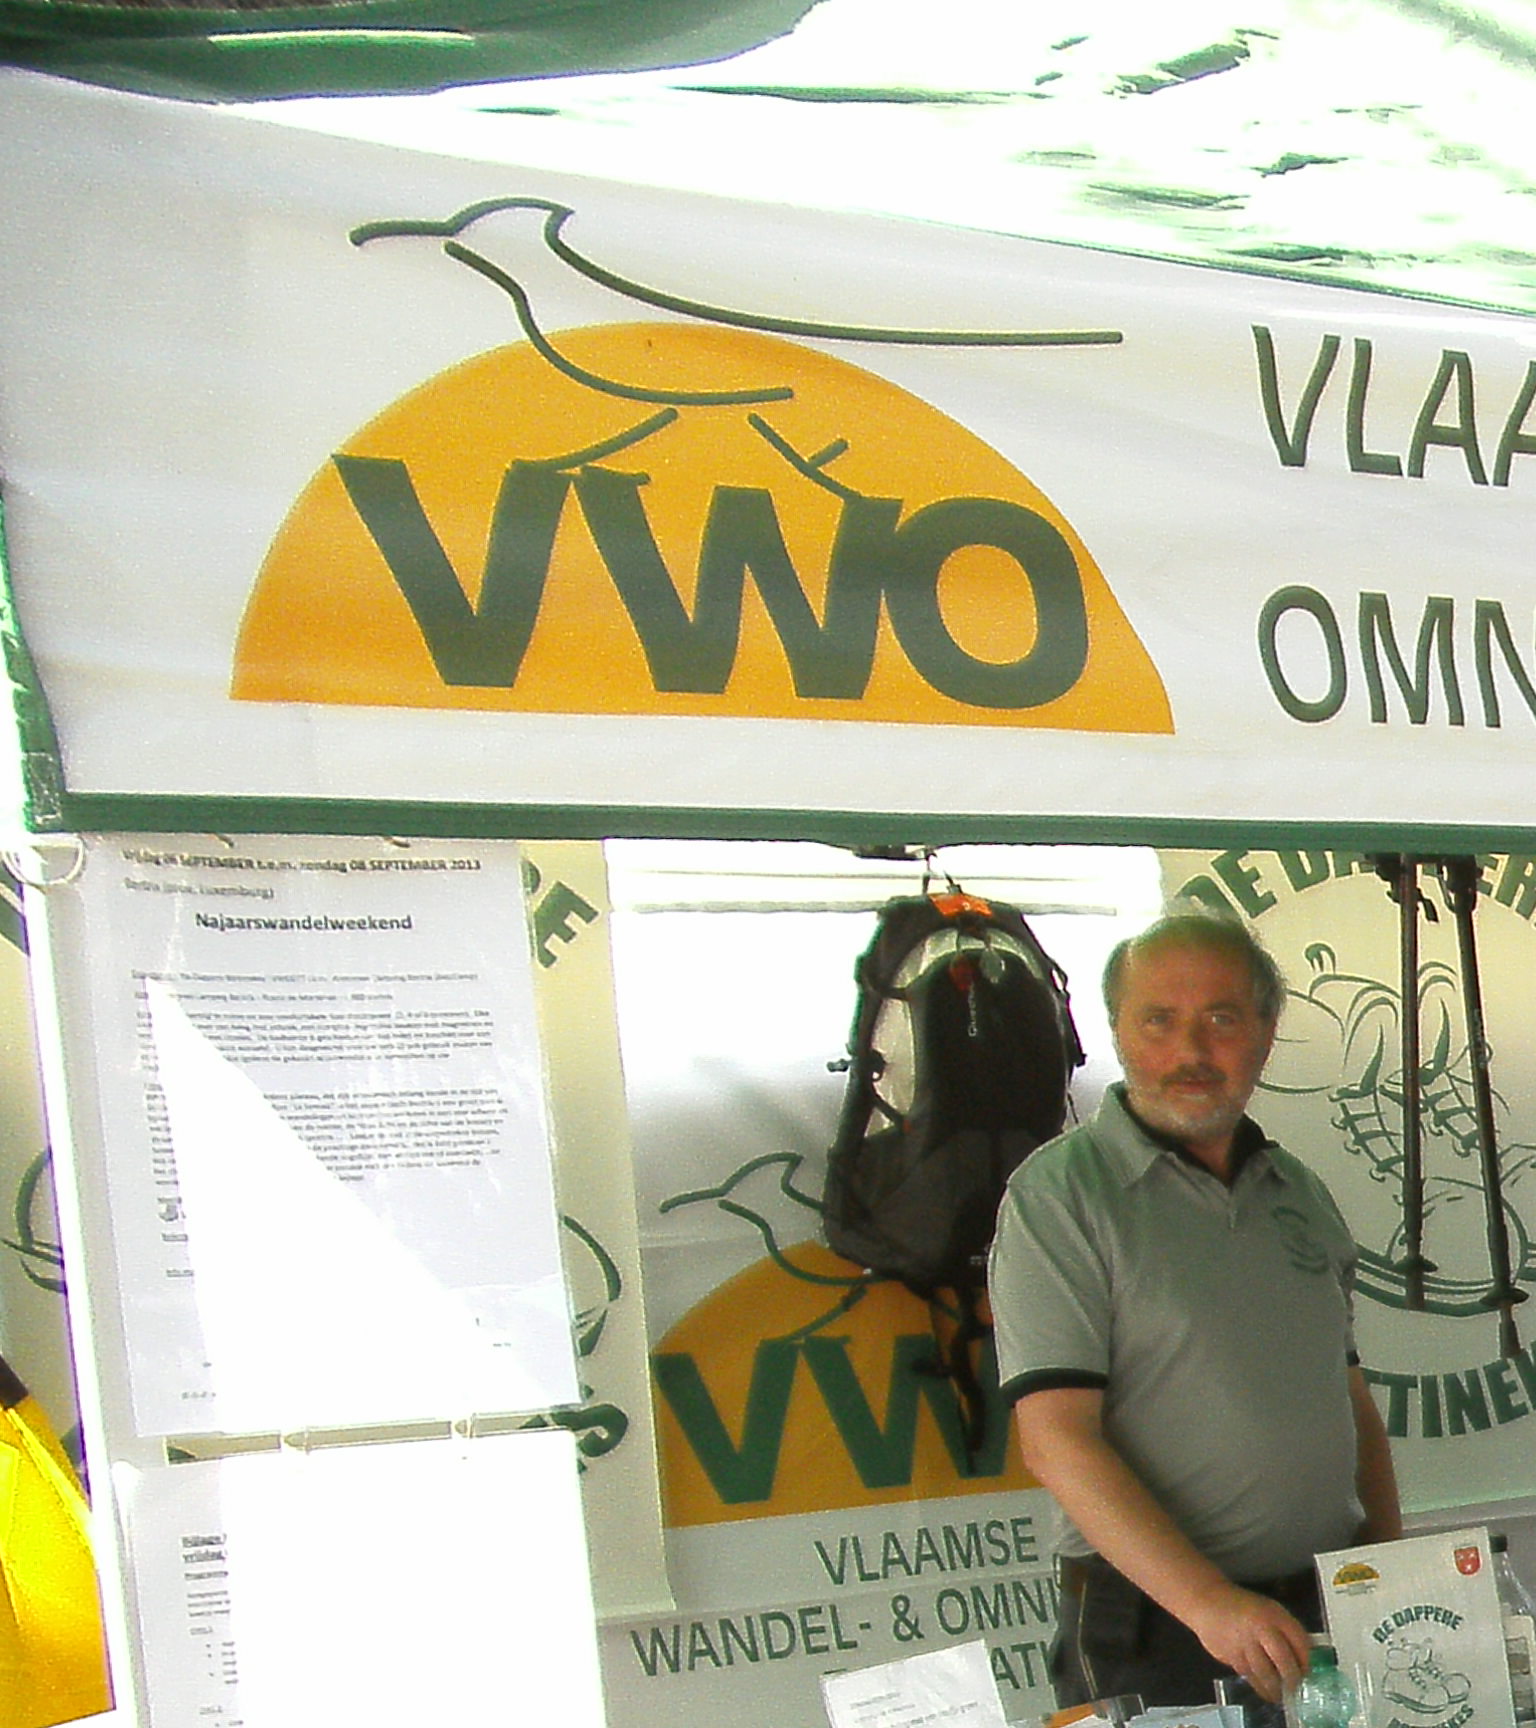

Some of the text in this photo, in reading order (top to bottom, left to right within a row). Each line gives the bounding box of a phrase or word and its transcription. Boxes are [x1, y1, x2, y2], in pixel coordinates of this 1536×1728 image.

[331, 453, 1091, 710] VWO
[450, 860, 481, 870] 2013
[195, 913, 413, 932] Najaarswandelweekend
[814, 1516, 1040, 1586] VLAAMSE
[630, 1603, 871, 1677] WANDEL-
[892, 1594, 925, 1642] &
